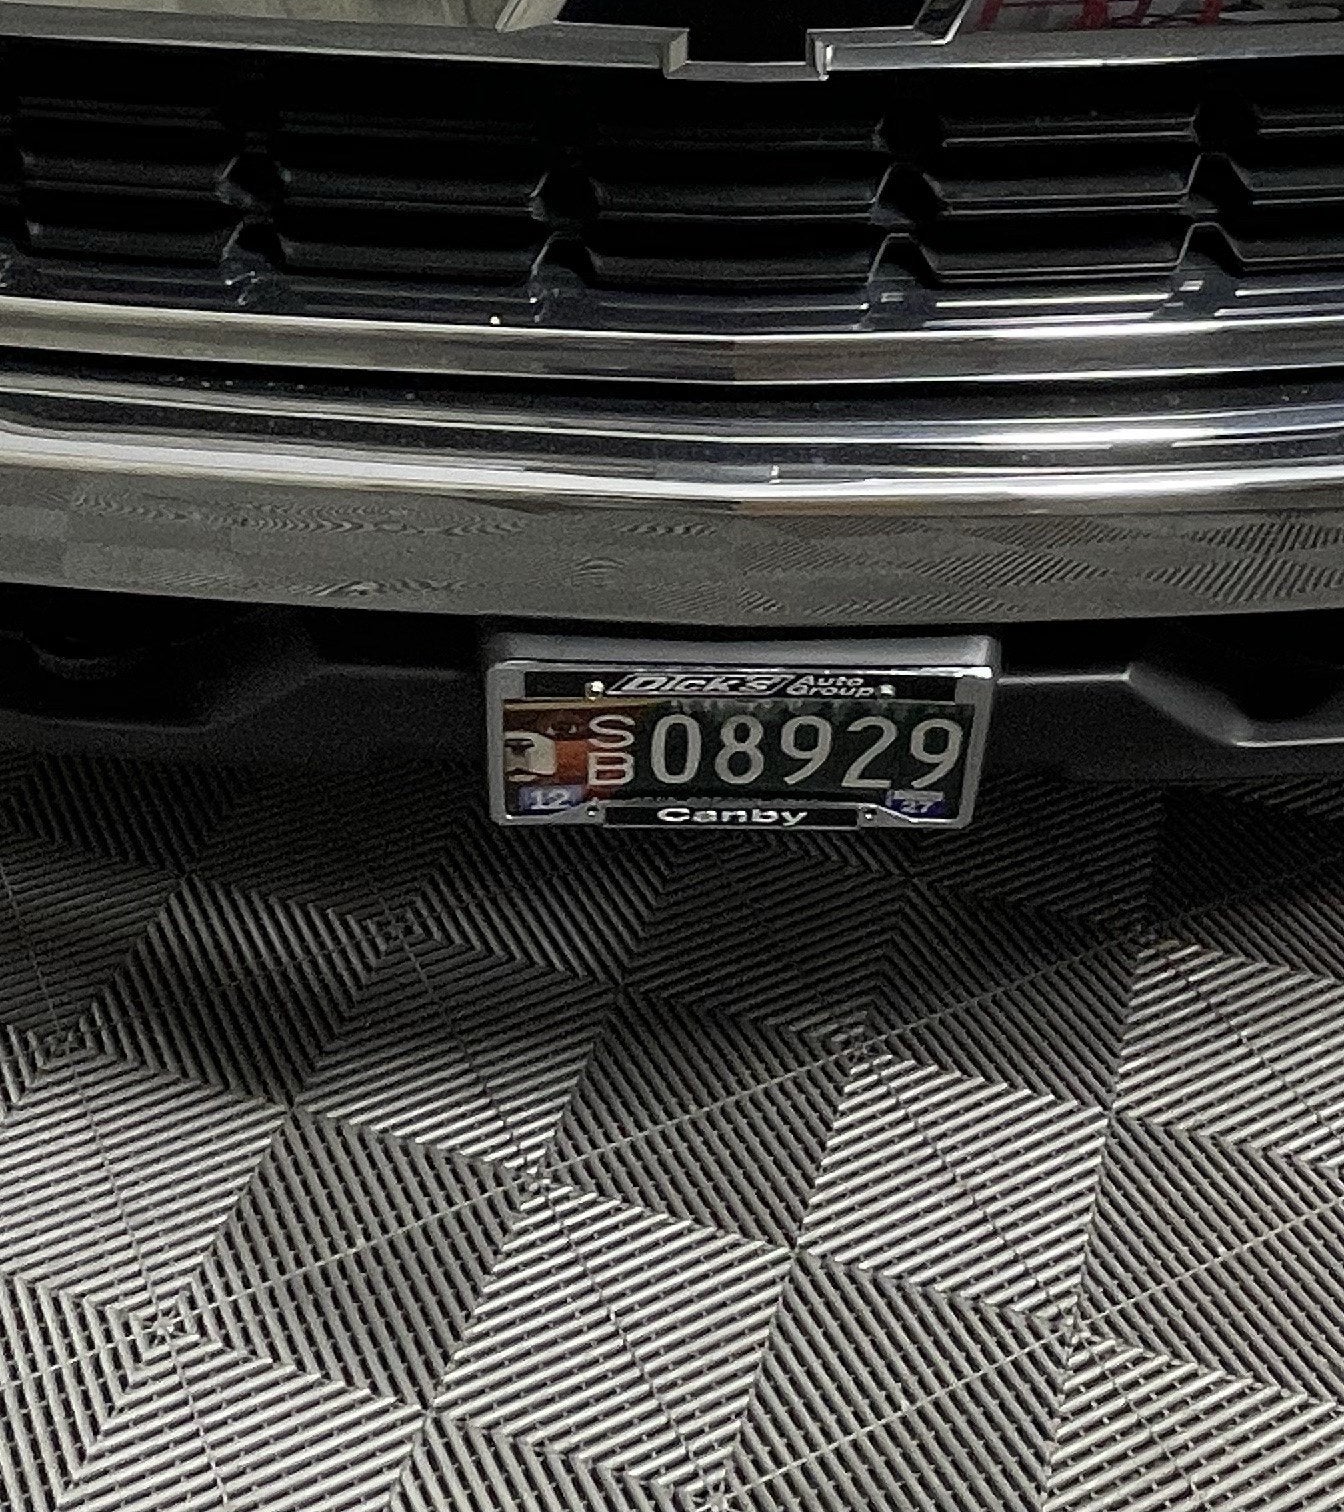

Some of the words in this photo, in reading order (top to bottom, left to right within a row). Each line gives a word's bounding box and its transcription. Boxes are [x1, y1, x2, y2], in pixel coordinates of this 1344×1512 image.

[801, 675, 864, 686] Auto
[786, 683, 875, 697] Group
[650, 714, 963, 788] 08929
[657, 808, 808, 827] Canby
